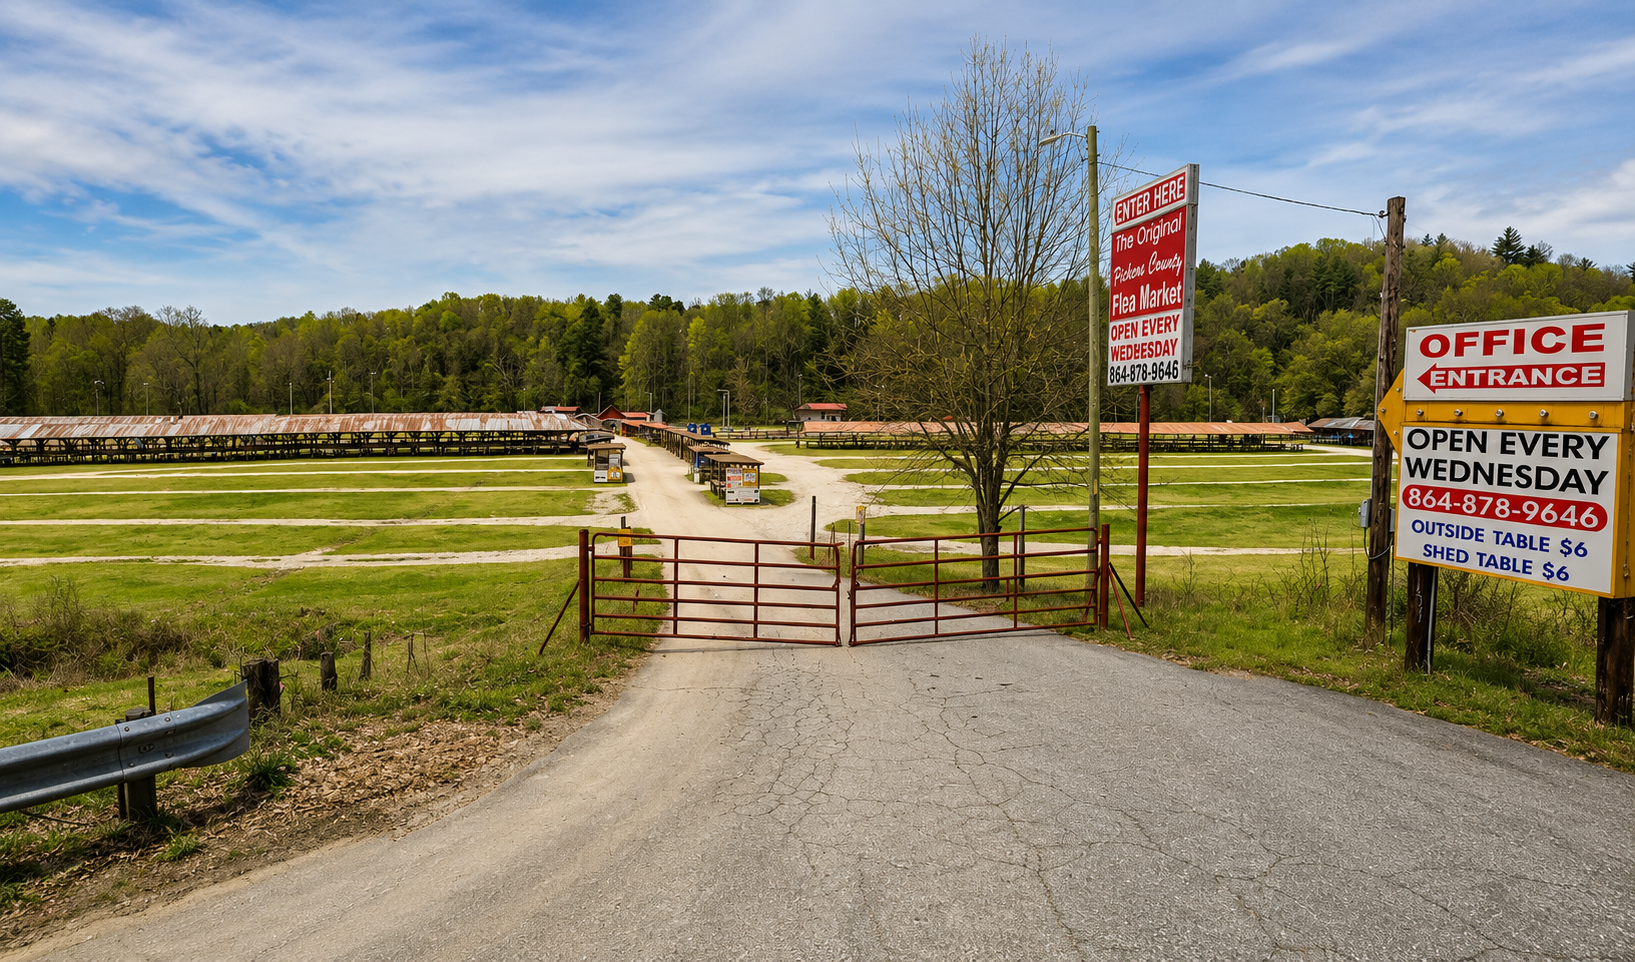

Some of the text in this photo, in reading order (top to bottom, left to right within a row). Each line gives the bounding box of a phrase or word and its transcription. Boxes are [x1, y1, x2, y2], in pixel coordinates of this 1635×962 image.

[1116, 176, 1185, 224] ENTER HERE
[1116, 212, 1182, 253] The Original
[1112, 281, 1182, 316] Flea Market
[1111, 314, 1180, 341] OPEN EVERY
[1419, 323, 1605, 358] OFFICE
[1109, 359, 1179, 383] 864-878-9646
[1430, 366, 1602, 387] ENTRANCE
[1407, 428, 1610, 460] OPEN EVERY
[1404, 457, 1609, 495] WEDNESDAY
[1407, 488, 1599, 529] 864-878-9646
[1411, 519, 1588, 558] OUTSIDE TABLE $6
[1422, 543, 1570, 582] SHED TABLE $6
